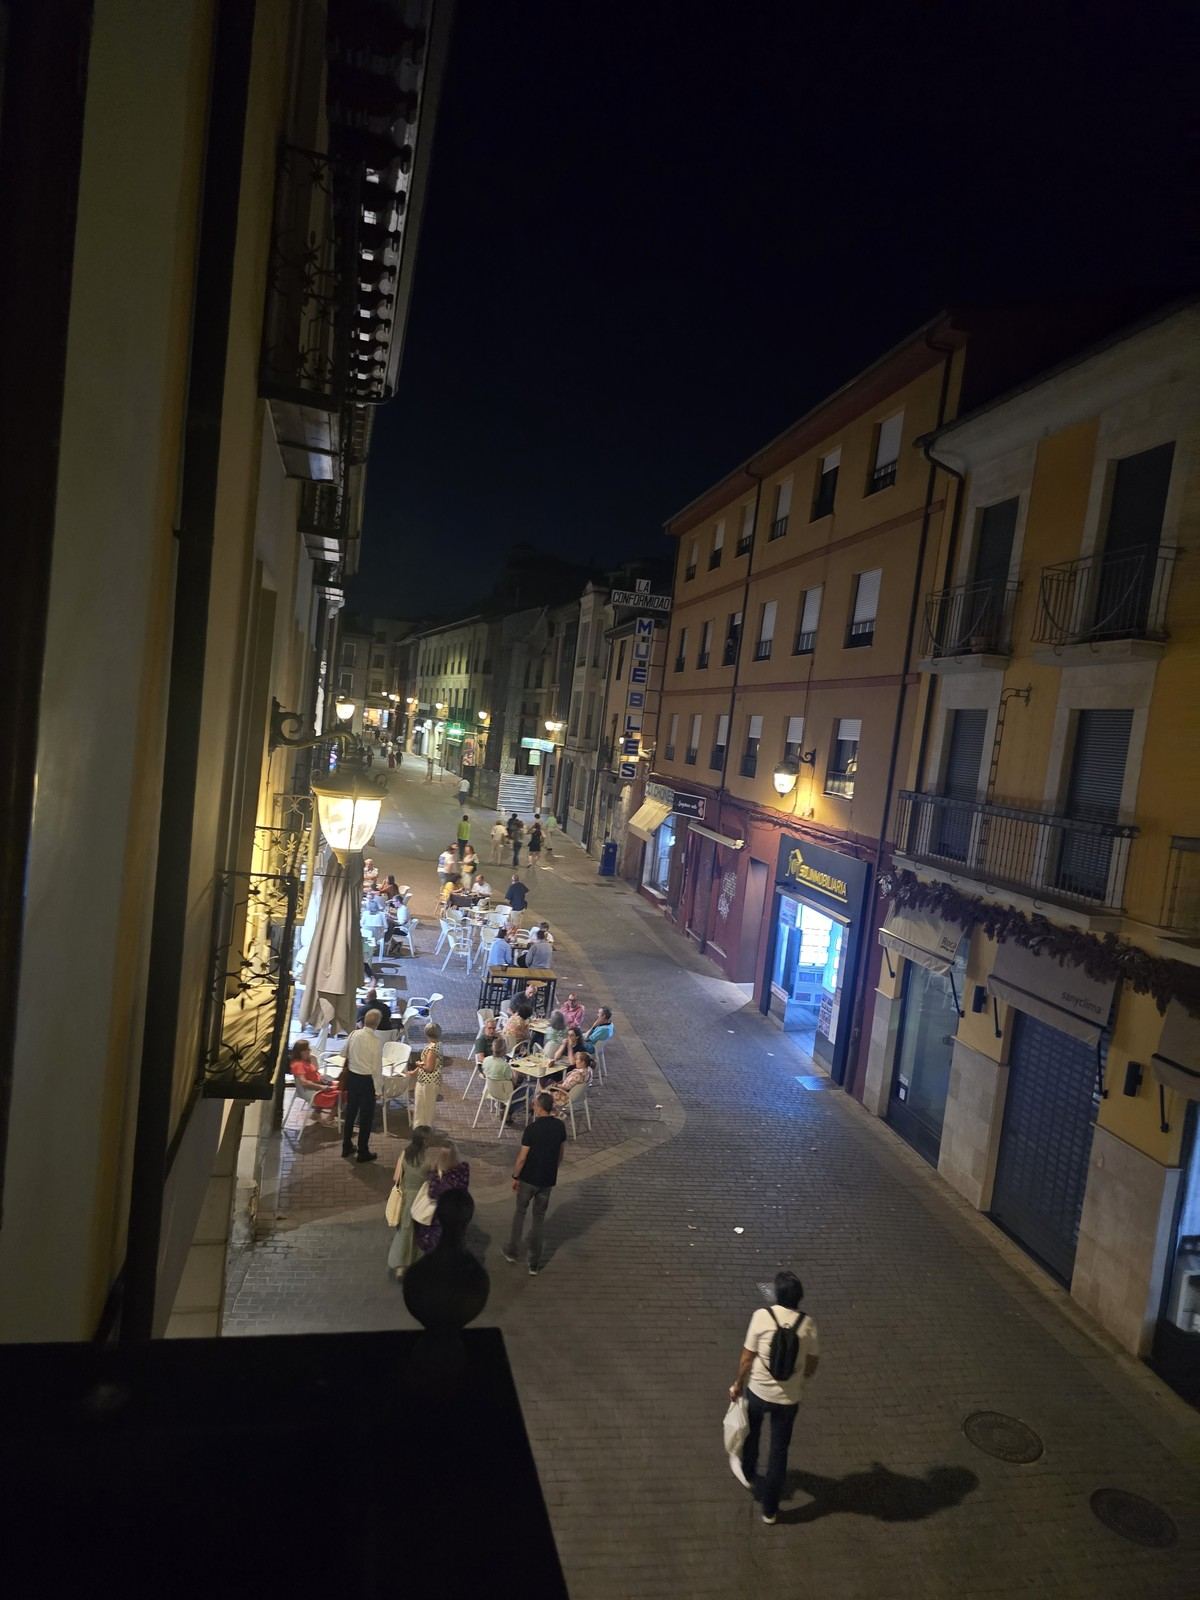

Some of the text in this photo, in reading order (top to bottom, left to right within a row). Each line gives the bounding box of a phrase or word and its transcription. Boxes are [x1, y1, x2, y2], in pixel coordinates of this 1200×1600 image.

[637, 580, 649, 593] LA
[612, 591, 671, 610] CONFORMIDAD
[621, 619, 652, 778] MUEBLES
